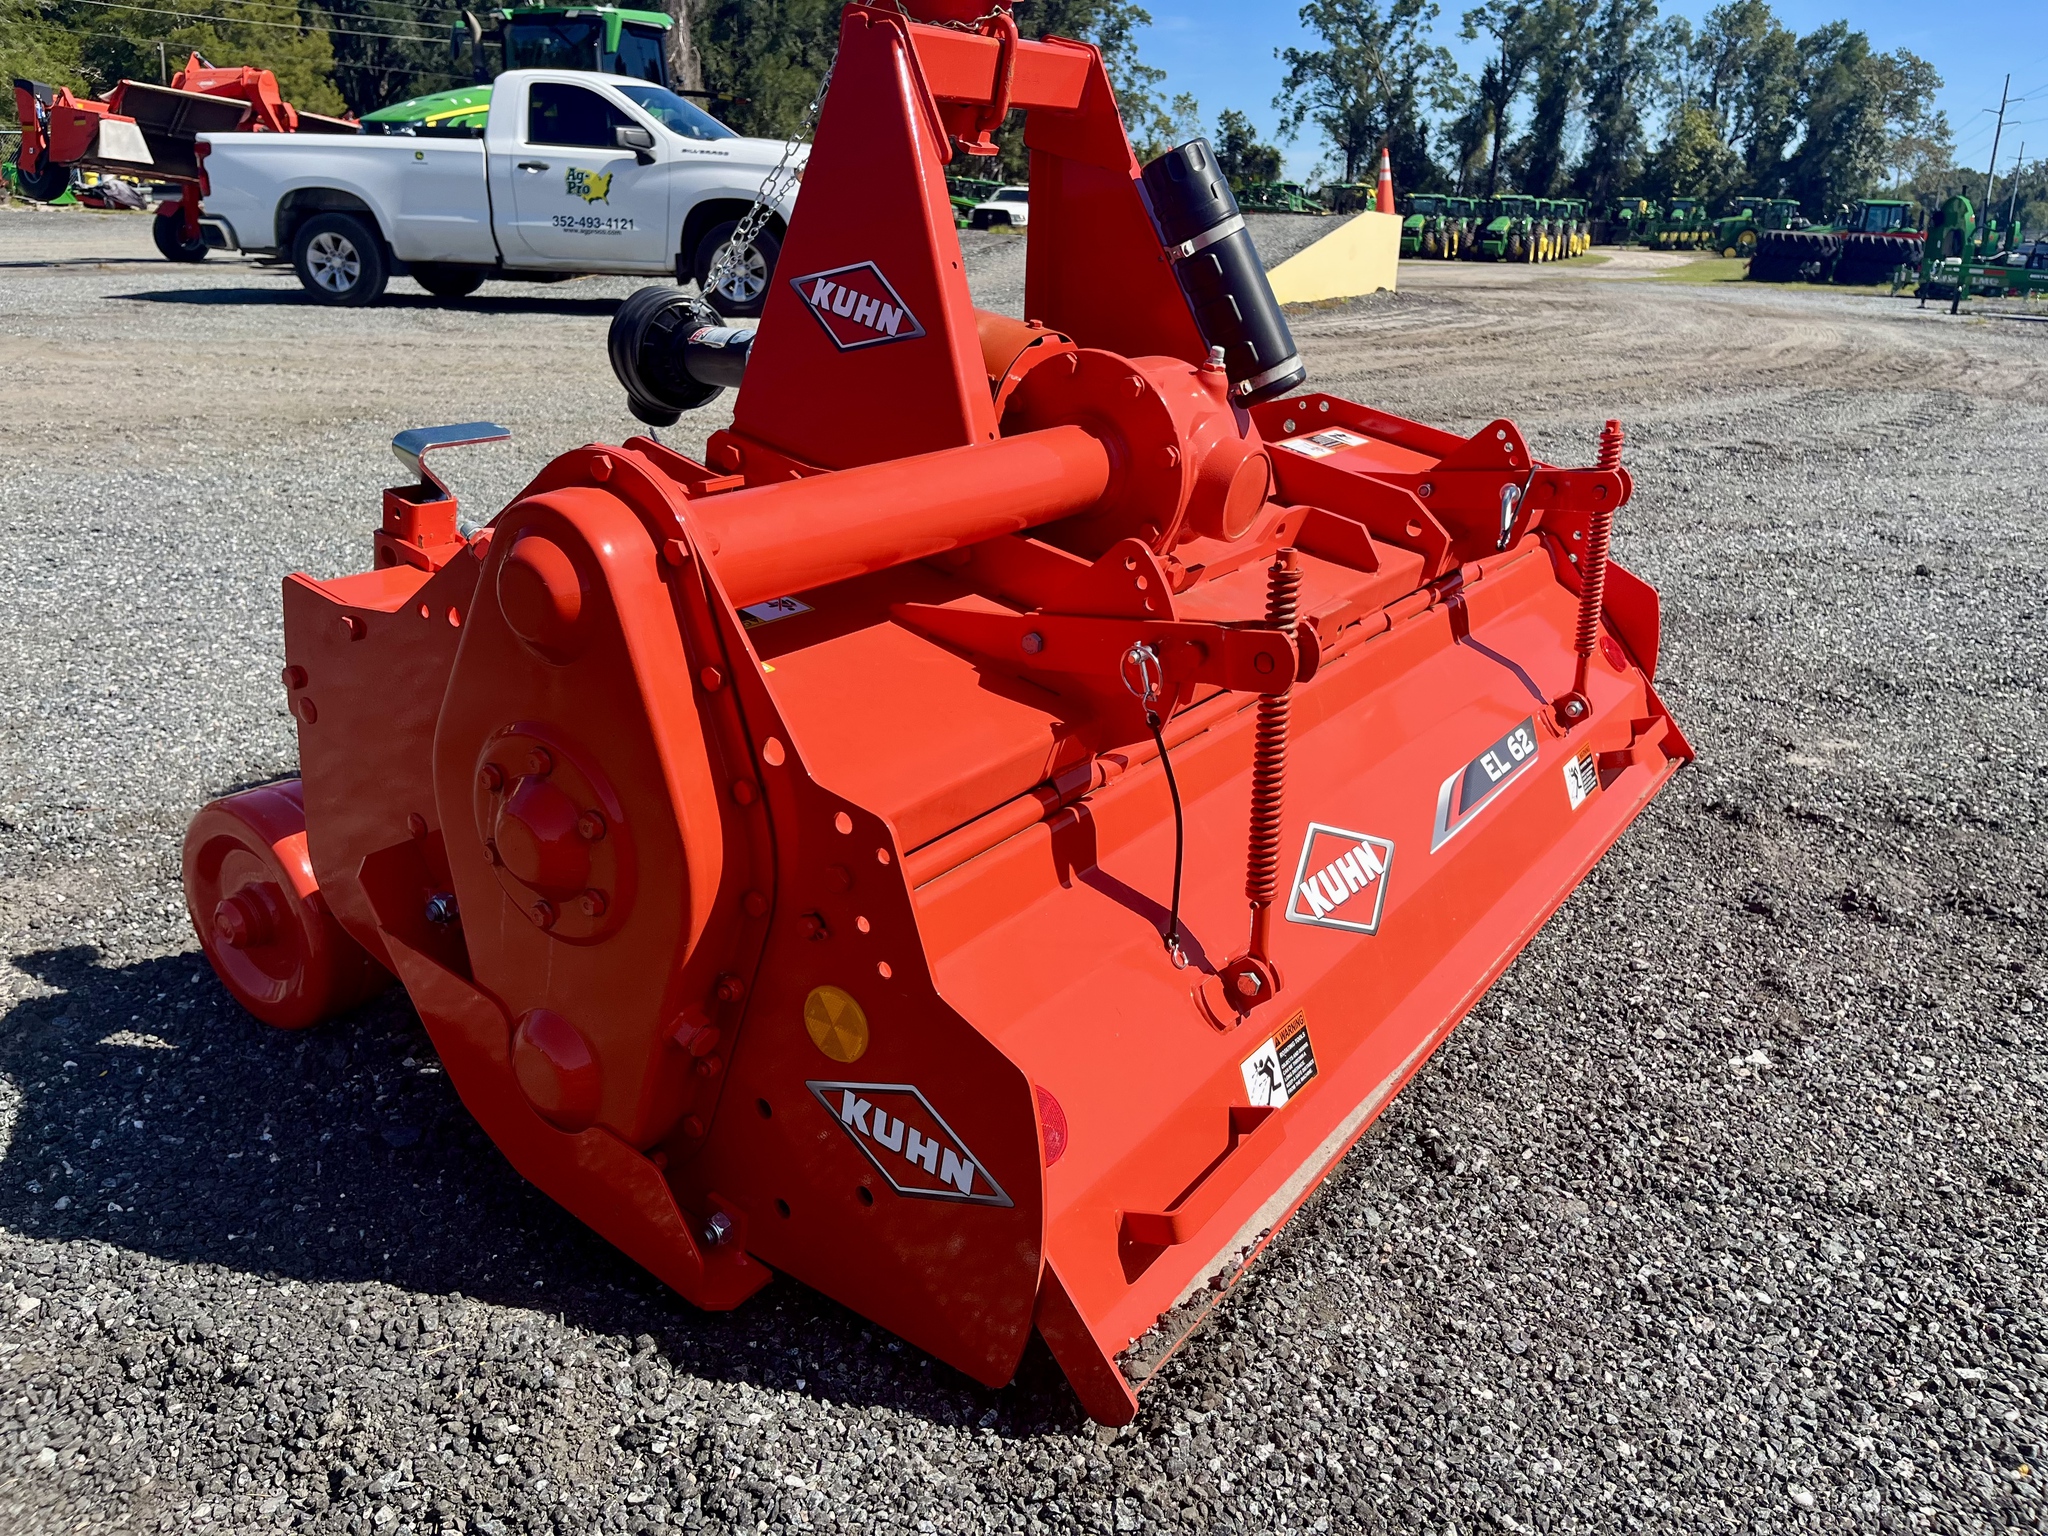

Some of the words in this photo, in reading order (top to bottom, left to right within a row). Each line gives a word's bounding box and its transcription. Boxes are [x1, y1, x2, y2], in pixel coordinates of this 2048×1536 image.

[566, 167, 590, 184] Ag-
[566, 181, 591, 195] Pro
[552, 215, 635, 230] 352-493-4121
[810, 277, 904, 337] KUHN
[1479, 750, 1512, 783] EL
[1507, 728, 1535, 762] 62
[1299, 840, 1384, 920] KUHN
[1279, 1015, 1305, 1042] WARNING
[841, 1088, 976, 1196] KUHN
